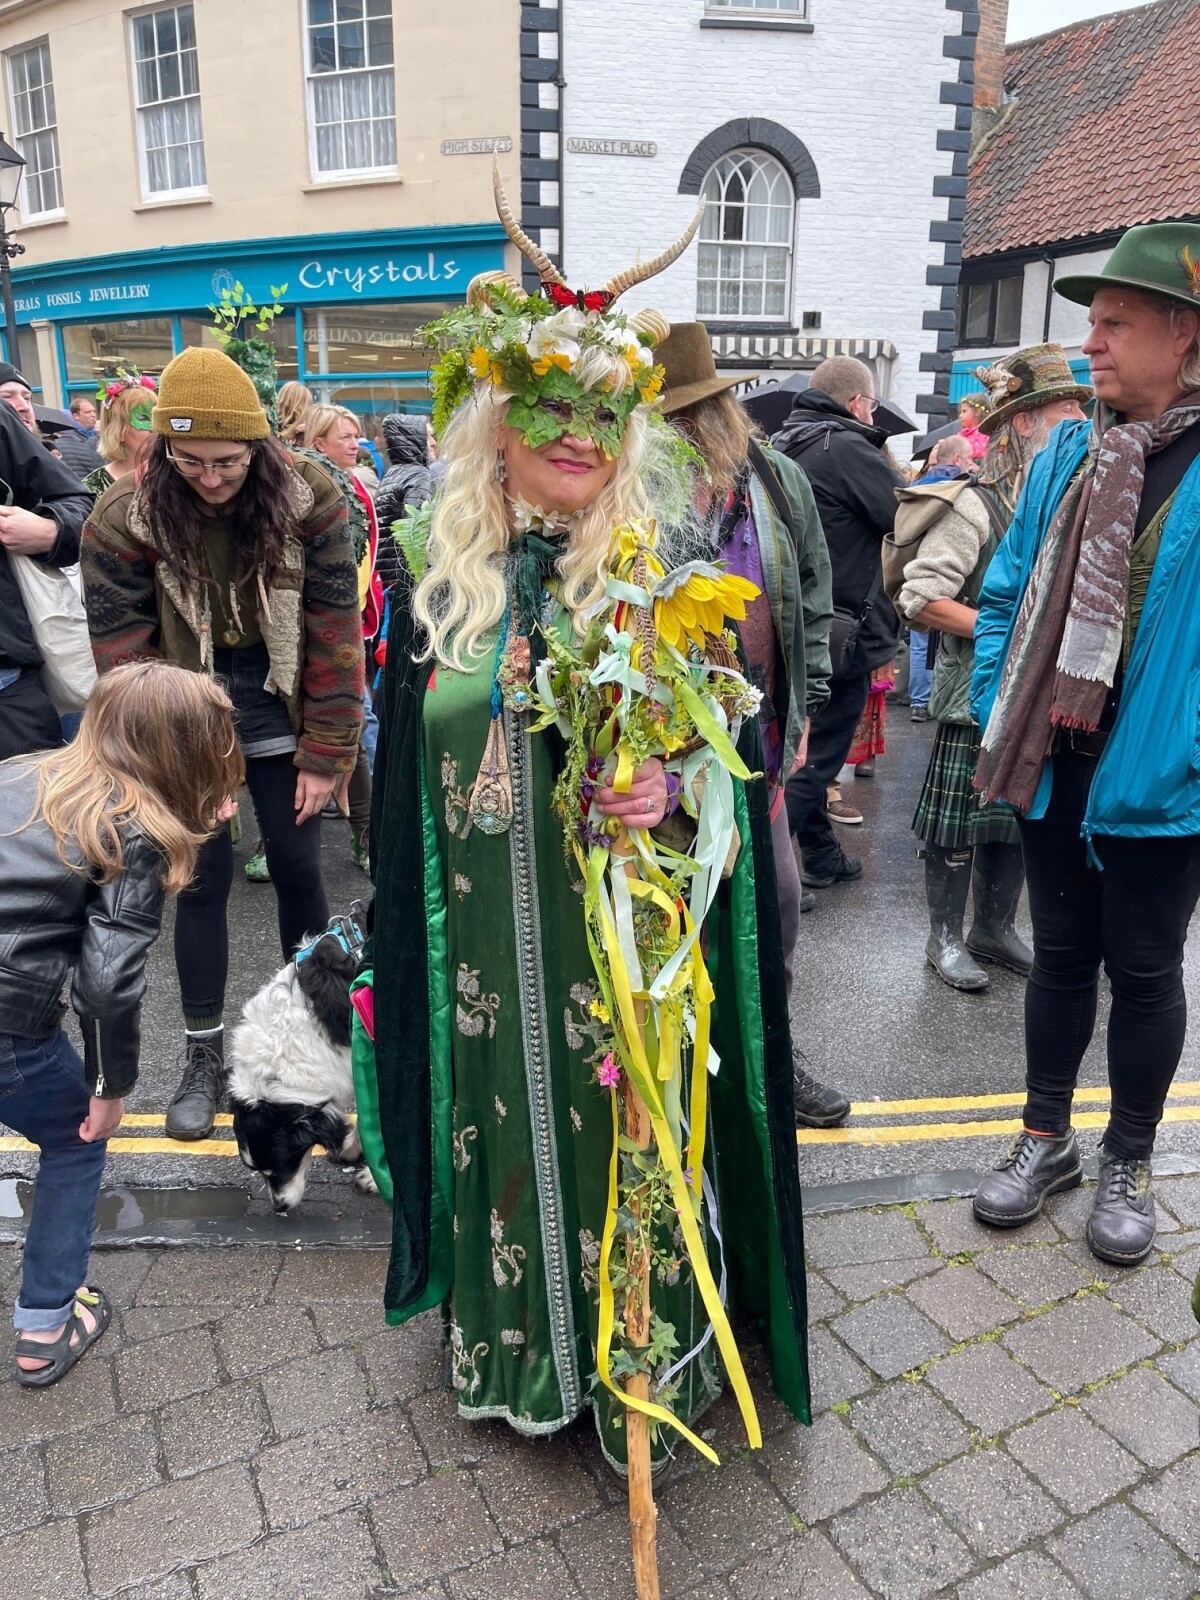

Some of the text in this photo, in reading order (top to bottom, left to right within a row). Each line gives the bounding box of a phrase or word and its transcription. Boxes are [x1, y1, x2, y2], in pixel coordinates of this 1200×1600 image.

[443, 138, 510, 153] HIGH STREET
[571, 140, 654, 155] MARKET PLACE
[298, 252, 461, 293] Crystals
[47, 290, 82, 307] FOSSILS
[89, 284, 151, 302] JEWELLERY
